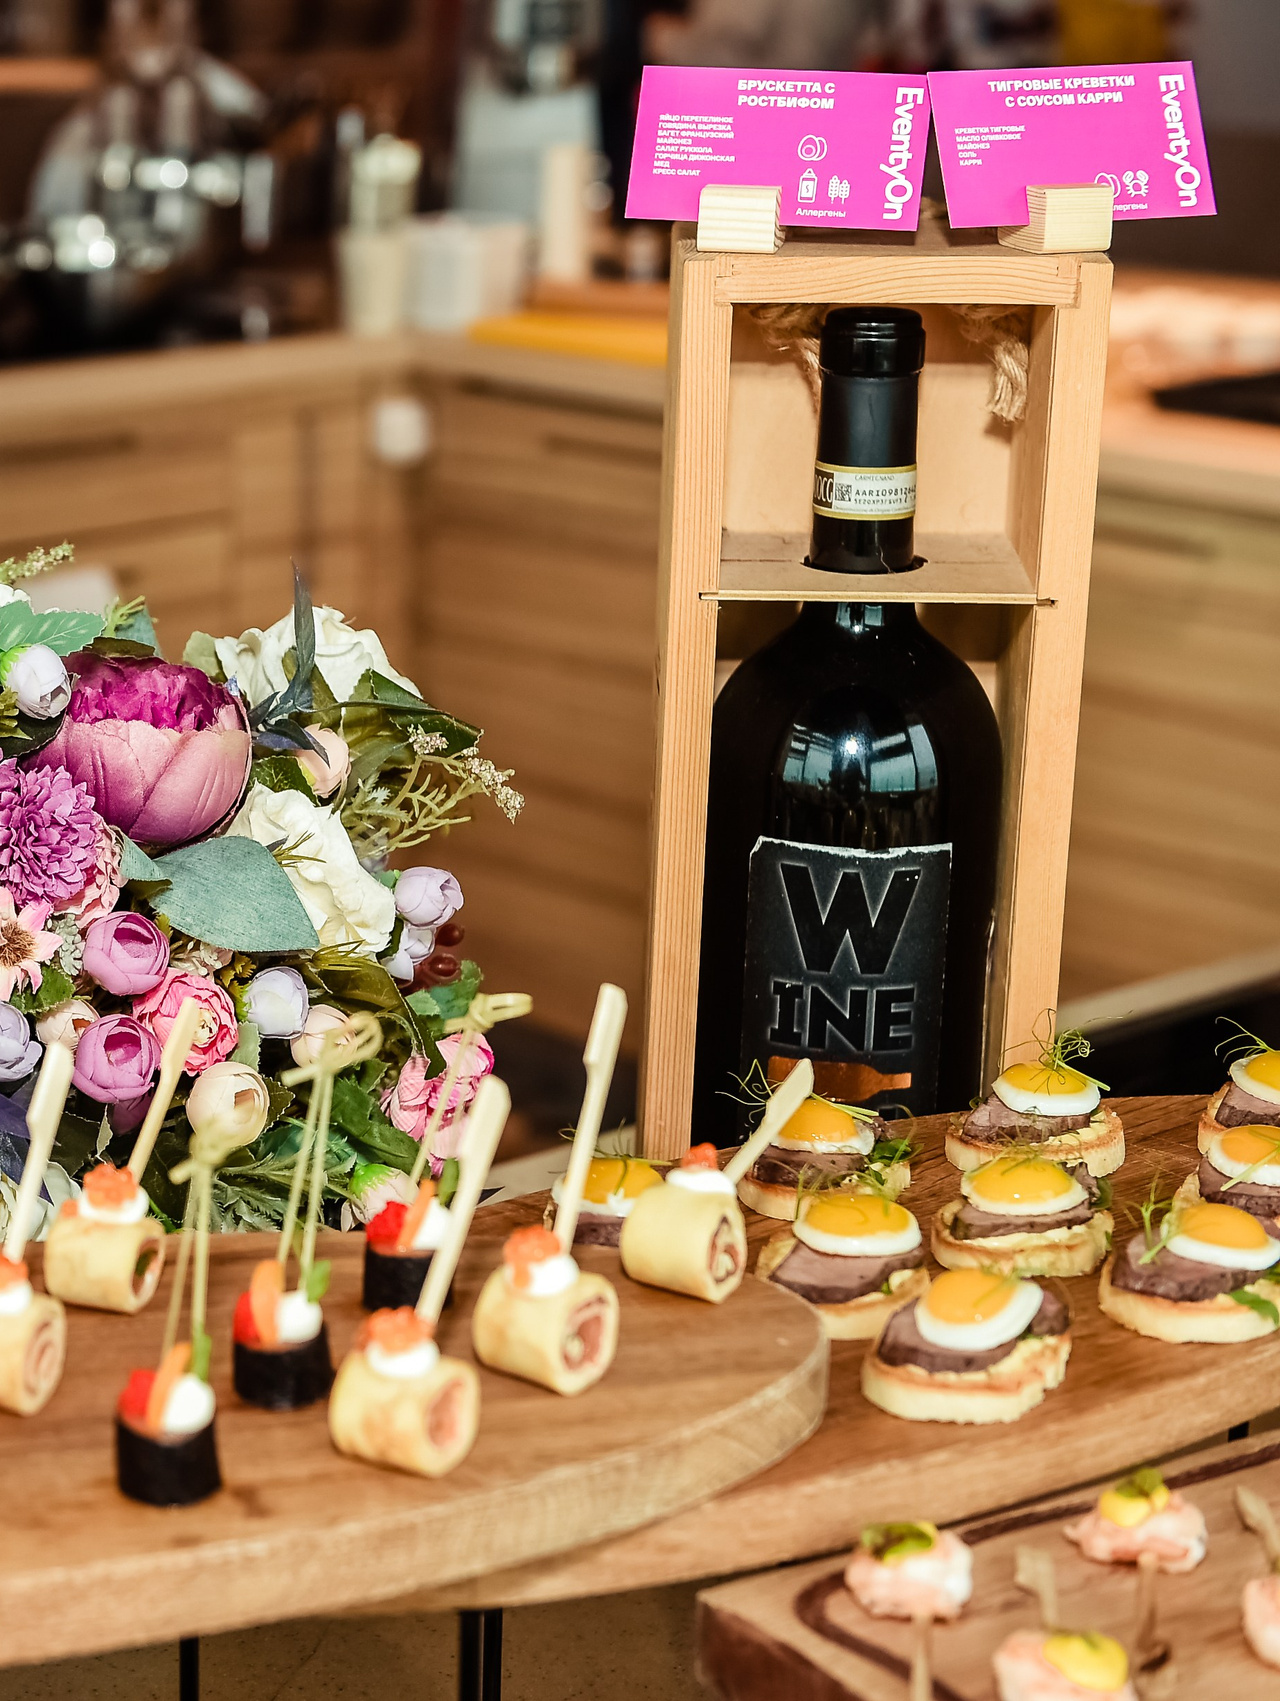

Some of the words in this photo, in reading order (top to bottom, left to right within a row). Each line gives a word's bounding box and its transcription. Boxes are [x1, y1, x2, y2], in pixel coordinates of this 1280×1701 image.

[737, 79, 822, 93] БРУСКЕТТА
[824, 82, 836, 94] С
[988, 77, 1063, 92] ТИГРОВЫЕ
[1064, 75, 1135, 90] КРЕВЕТКИ
[737, 95, 835, 109] РОСТБИФОМ
[1005, 96, 1015, 108] С
[1017, 94, 1075, 107] СОУСОМ
[1078, 91, 1123, 105] КАРРИ
[659, 114, 680, 122] ЯЙЦО
[681, 115, 734, 123] ПЕРЕПЕЛИНОЕ
[658, 122, 697, 130] ГОВЯДИНА
[656, 136, 692, 145] МАЙОНЕЗ
[680, 131, 735, 139] ФРАНЦУЗСКИЙ
[1158, 74, 1201, 208] EventyOn
[957, 142, 991, 150] МАЙОНЕЗ
[879, 87, 925, 220] EventyOn
[795, 207, 846, 218] Аллергены
